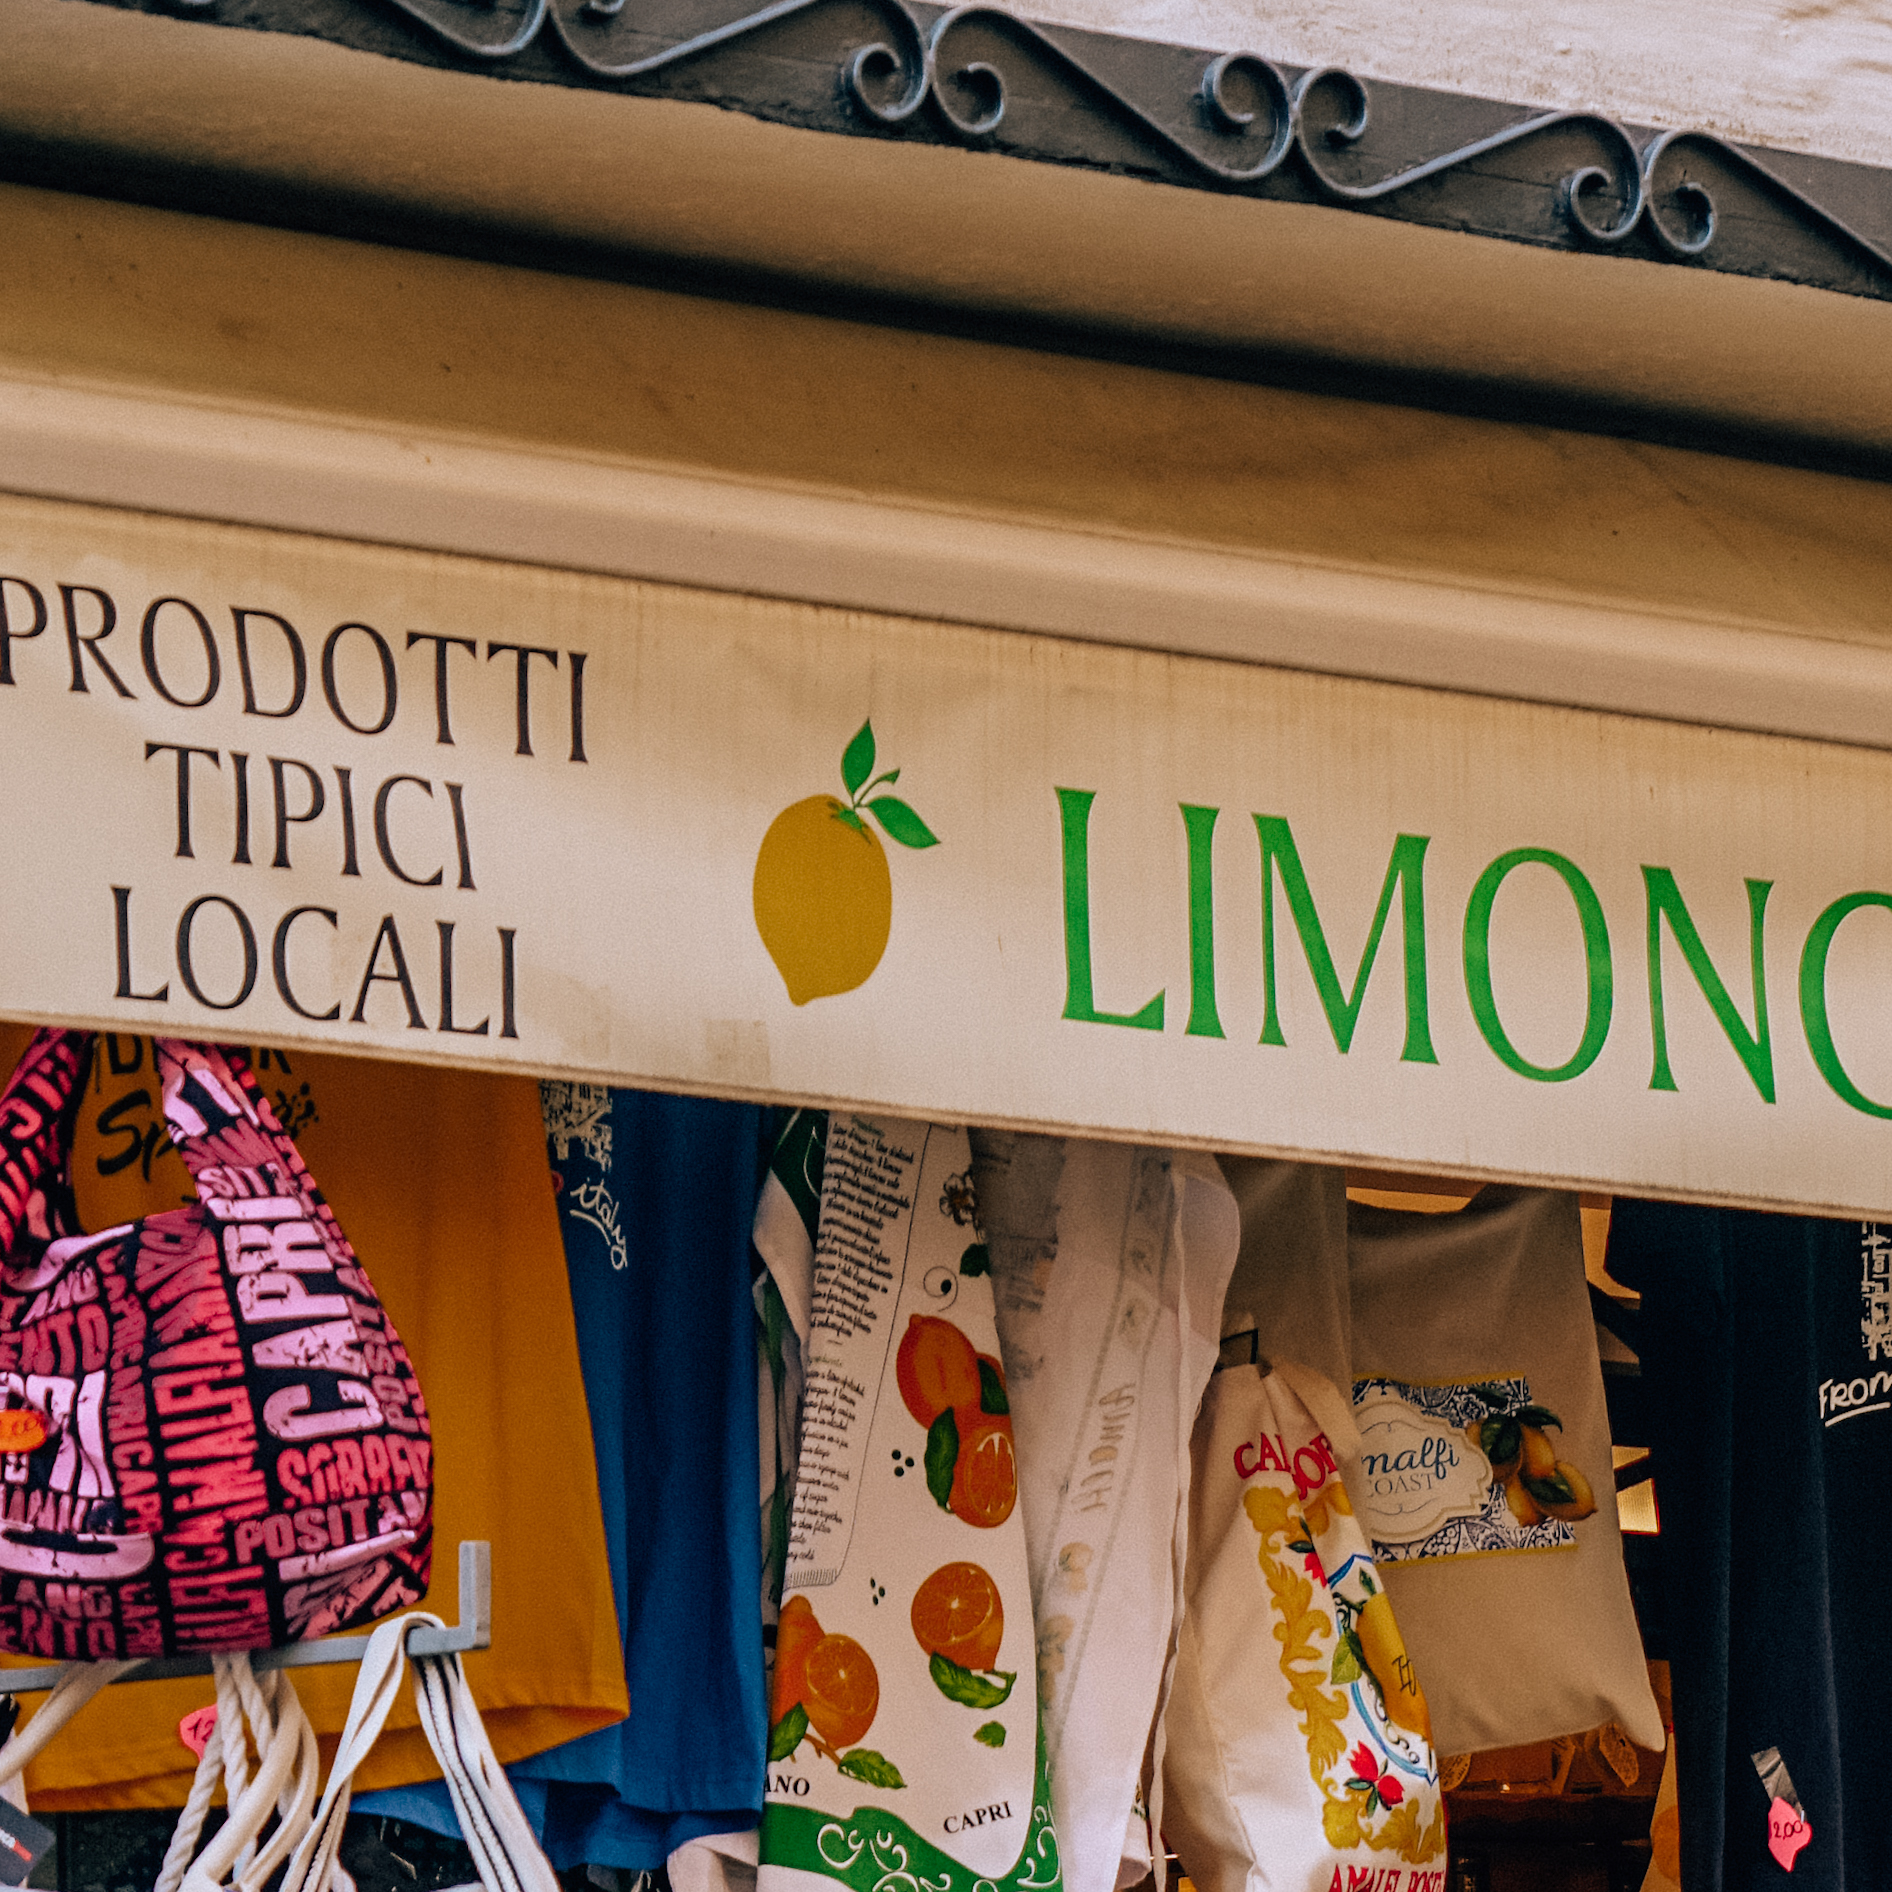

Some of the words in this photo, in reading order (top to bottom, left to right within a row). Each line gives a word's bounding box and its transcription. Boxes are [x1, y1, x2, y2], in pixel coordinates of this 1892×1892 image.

[0, 577, 589, 763] PRODOTTI
[145, 742, 477, 890] TIPICI
[111, 885, 519, 1040] LOCALI
[943, 1801, 1014, 1834] CAPRI
